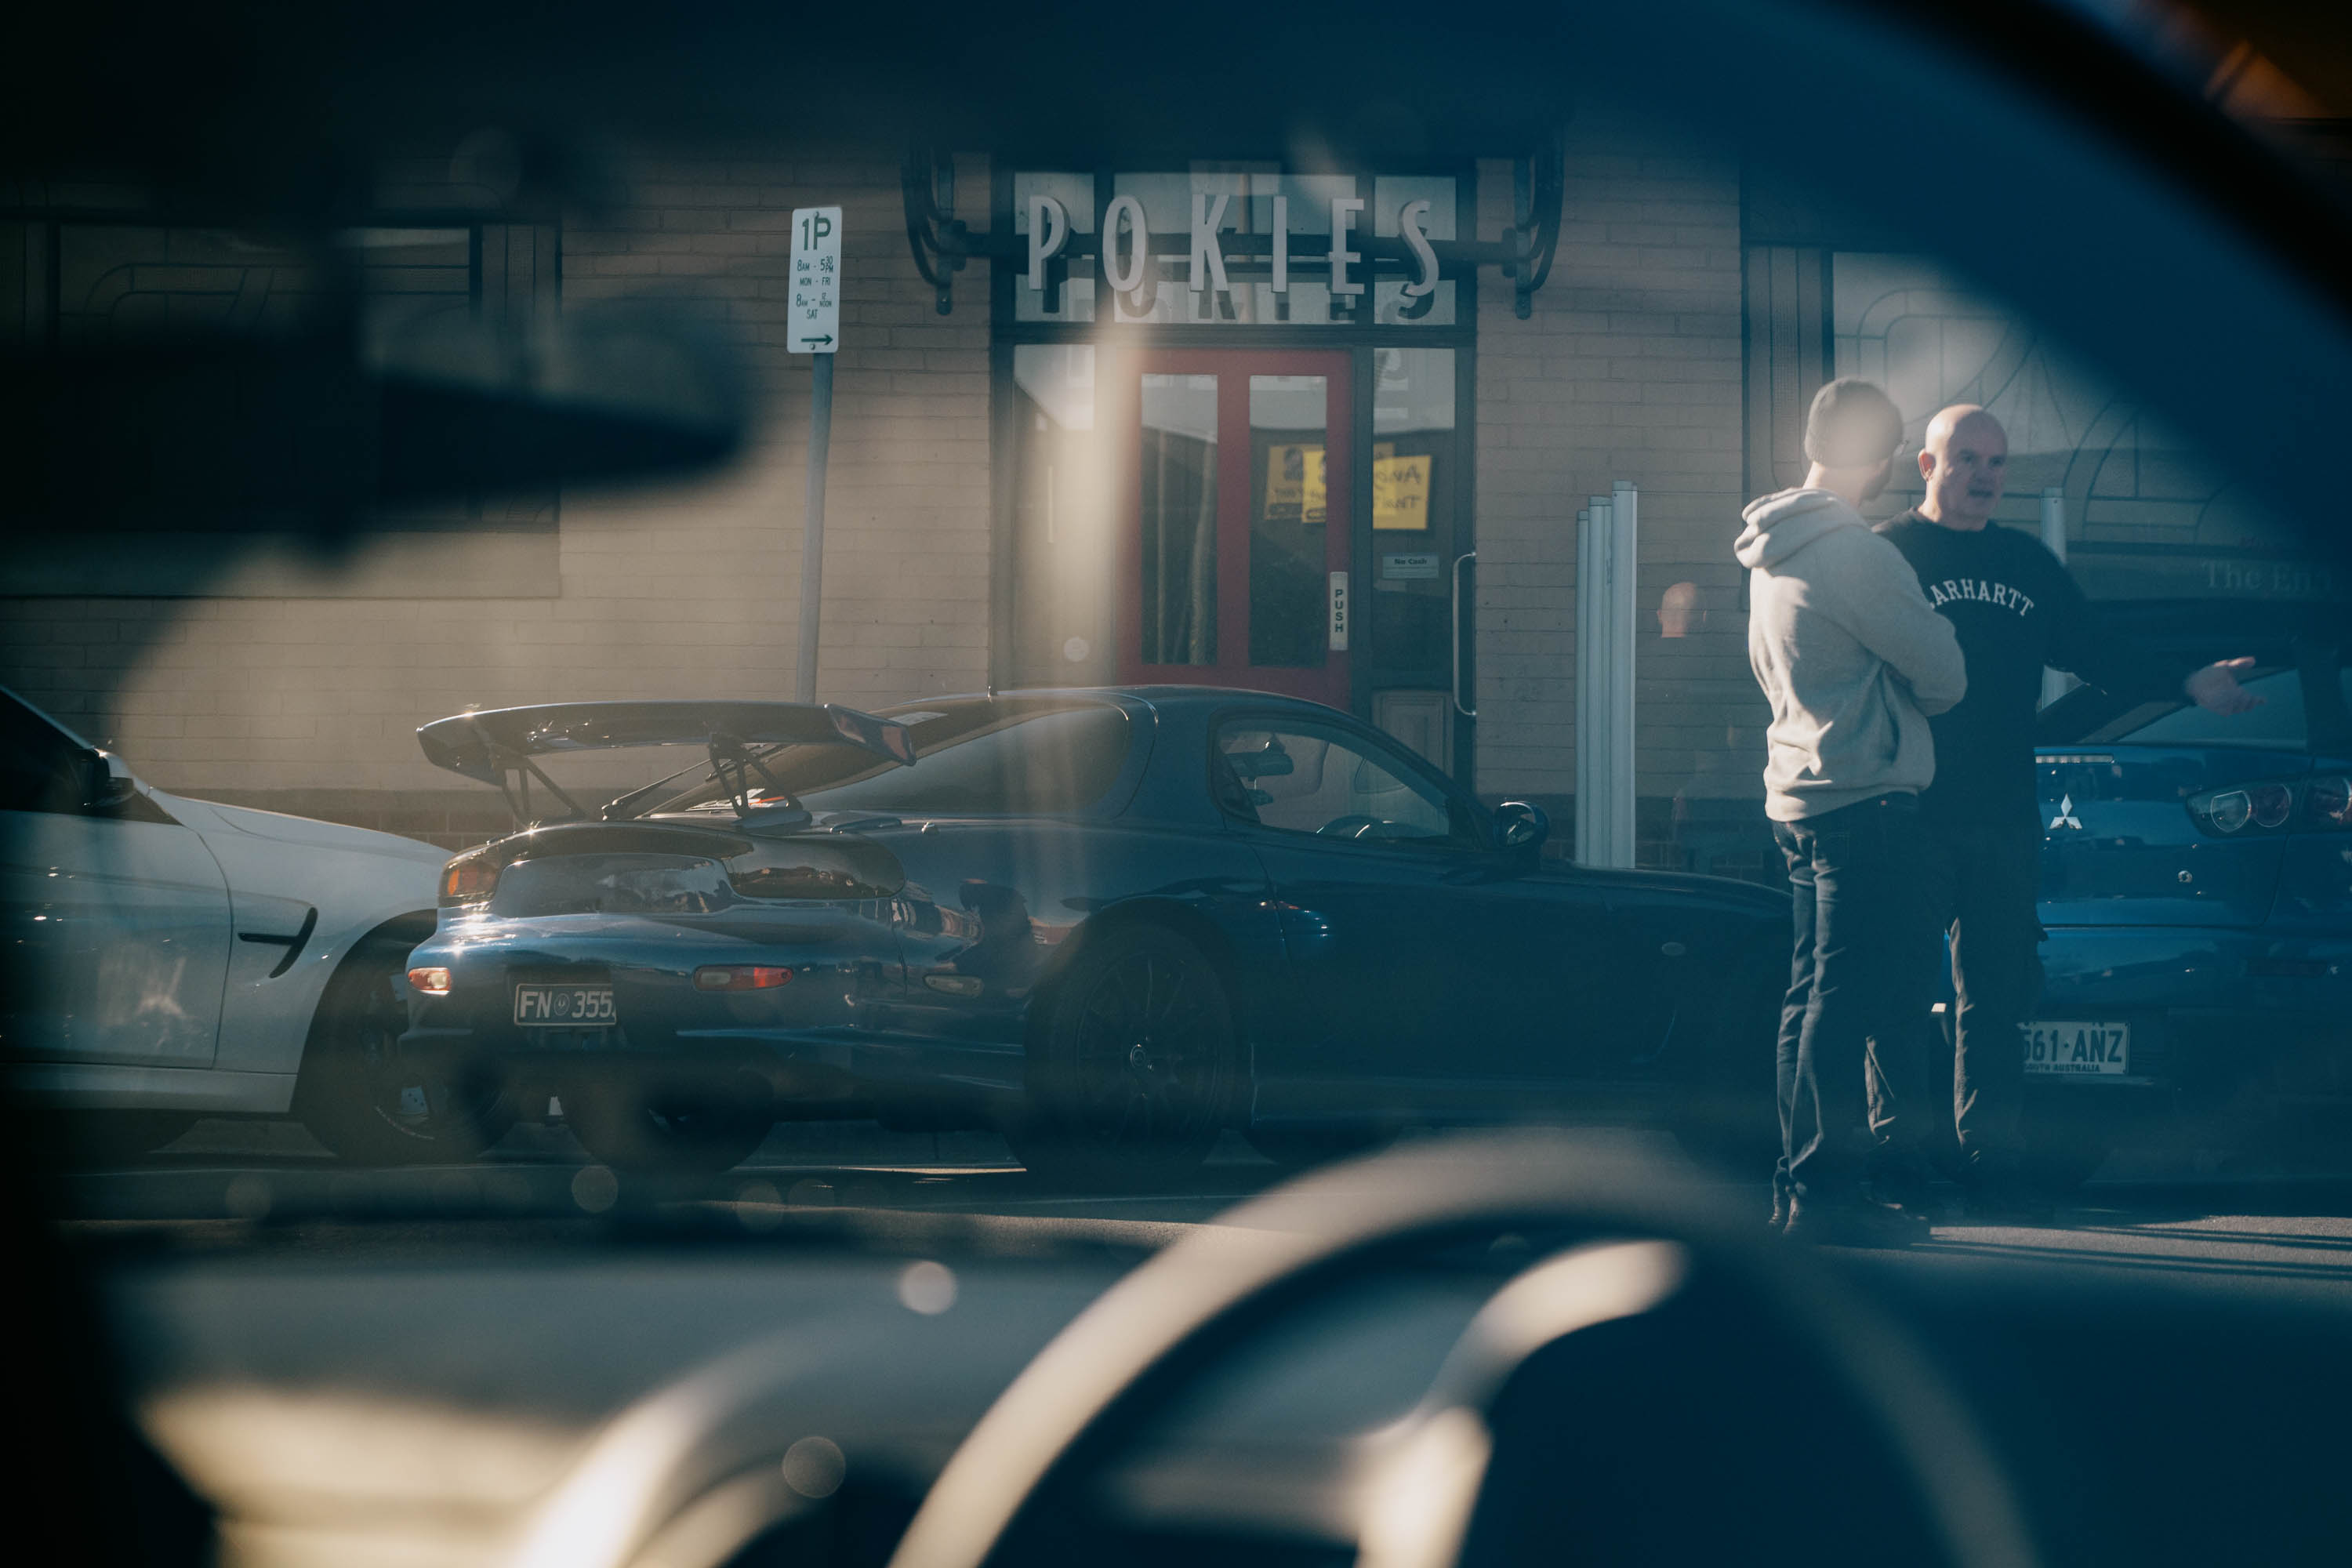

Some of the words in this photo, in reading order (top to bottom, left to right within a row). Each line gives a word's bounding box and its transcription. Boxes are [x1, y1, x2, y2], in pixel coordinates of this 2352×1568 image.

[802, 217, 831, 250] 1P
[1028, 194, 1439, 297] POKIES
[800, 278, 811, 286] MON
[822, 277, 831, 286] FRI
[807, 309, 818, 319] SAT
[2201, 560, 2261, 590] The
[1334, 589, 1344, 633] PUSH
[1929, 579, 2034, 616] ARHARTT
[519, 991, 552, 1018] FN
[572, 991, 616, 1018] 355
[2053, 1064, 2100, 1073] AUSTRALIA
